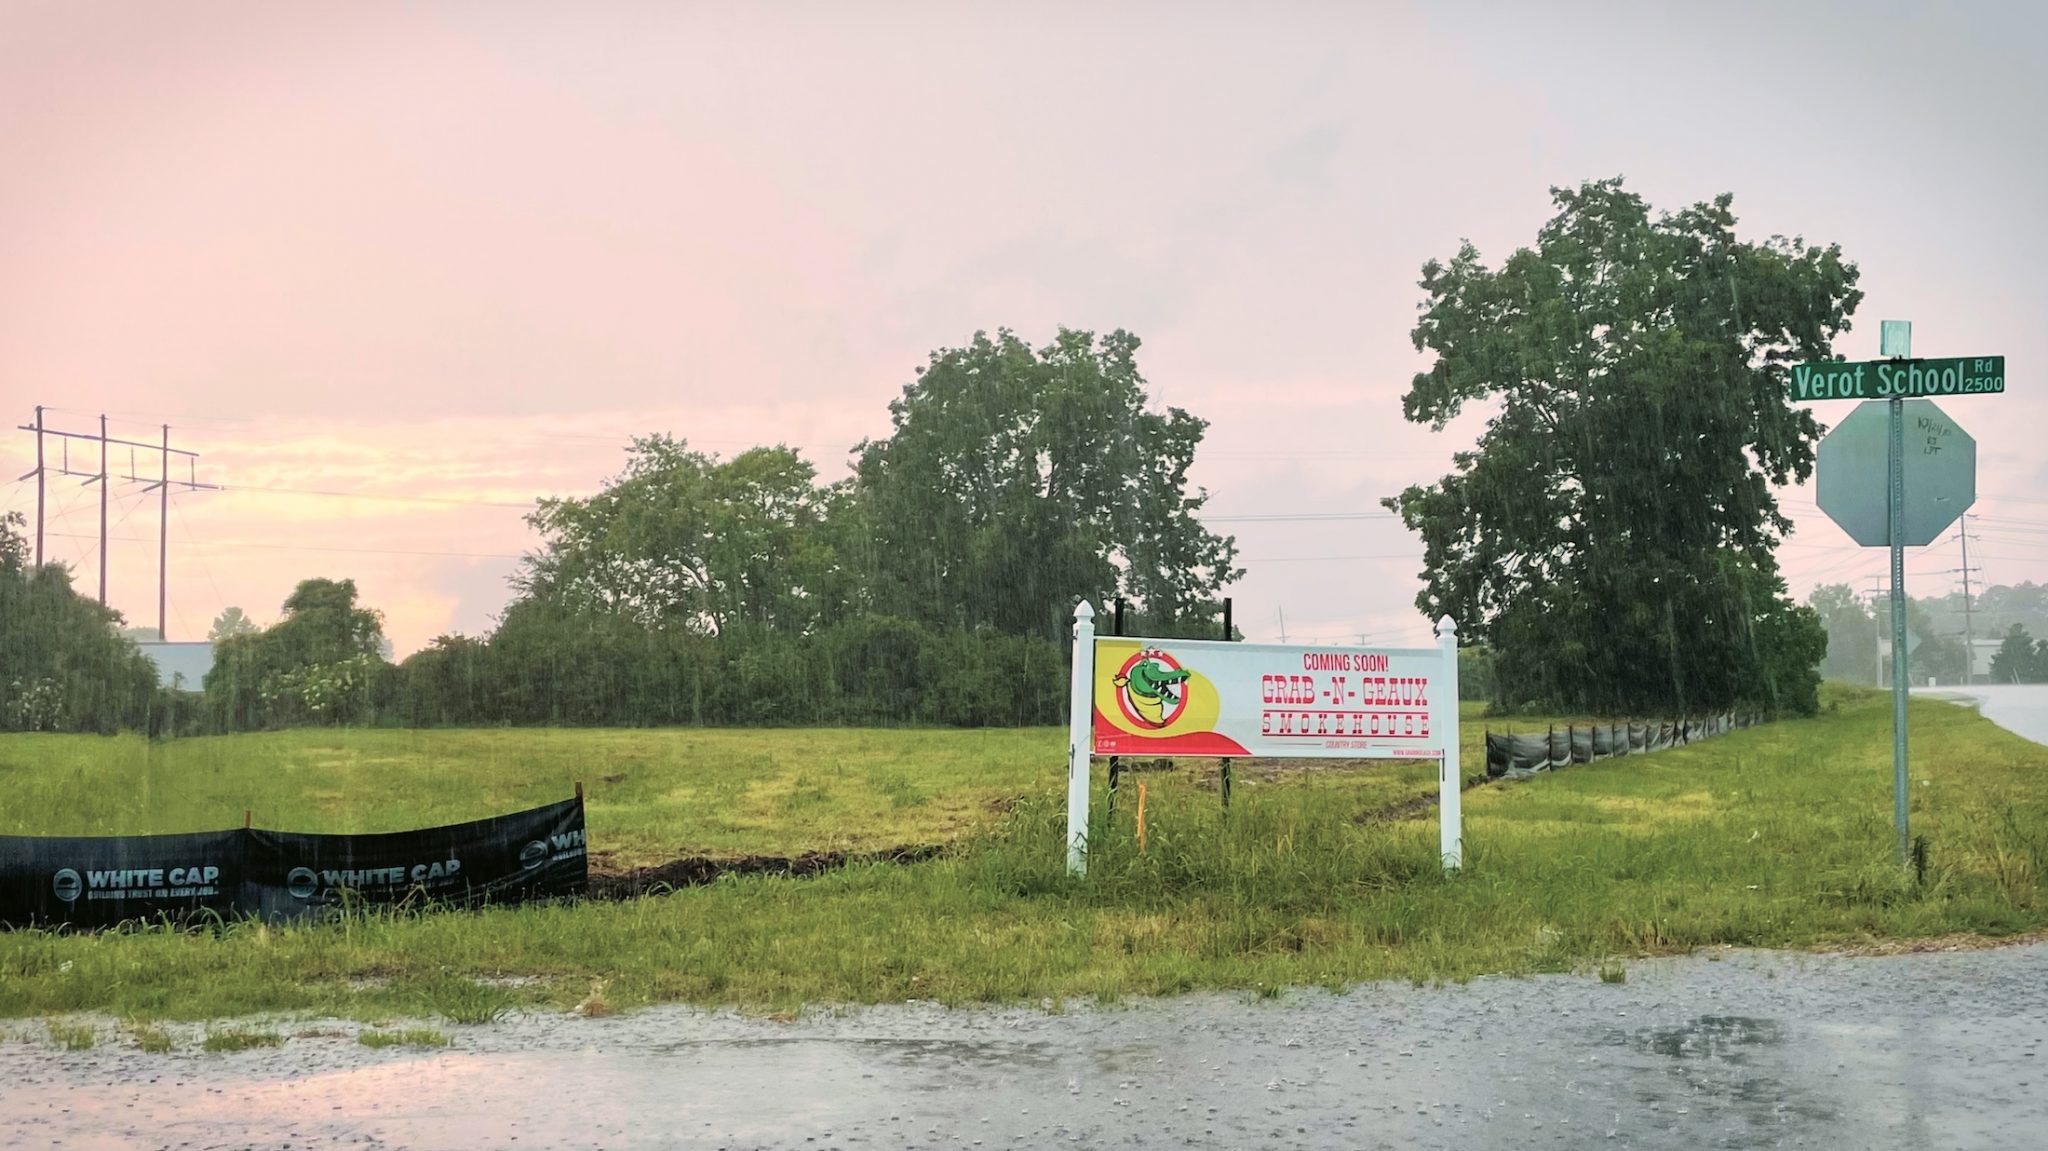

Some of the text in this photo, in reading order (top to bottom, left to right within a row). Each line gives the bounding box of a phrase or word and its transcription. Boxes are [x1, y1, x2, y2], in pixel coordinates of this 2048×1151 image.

[1795, 359, 1993, 398] Verot School Rd
[1965, 377, 2003, 392] 2500
[1303, 653, 1389, 672] COMING SOON!
[1262, 675, 1316, 704] GRAB
[1363, 677, 1428, 706] GEAUX
[1262, 713, 1429, 735] SMOKEHOUSE
[1351, 741, 1368, 749] STORE
[86, 868, 164, 888] WHITE
[323, 859, 460, 886] WHITE CAP
